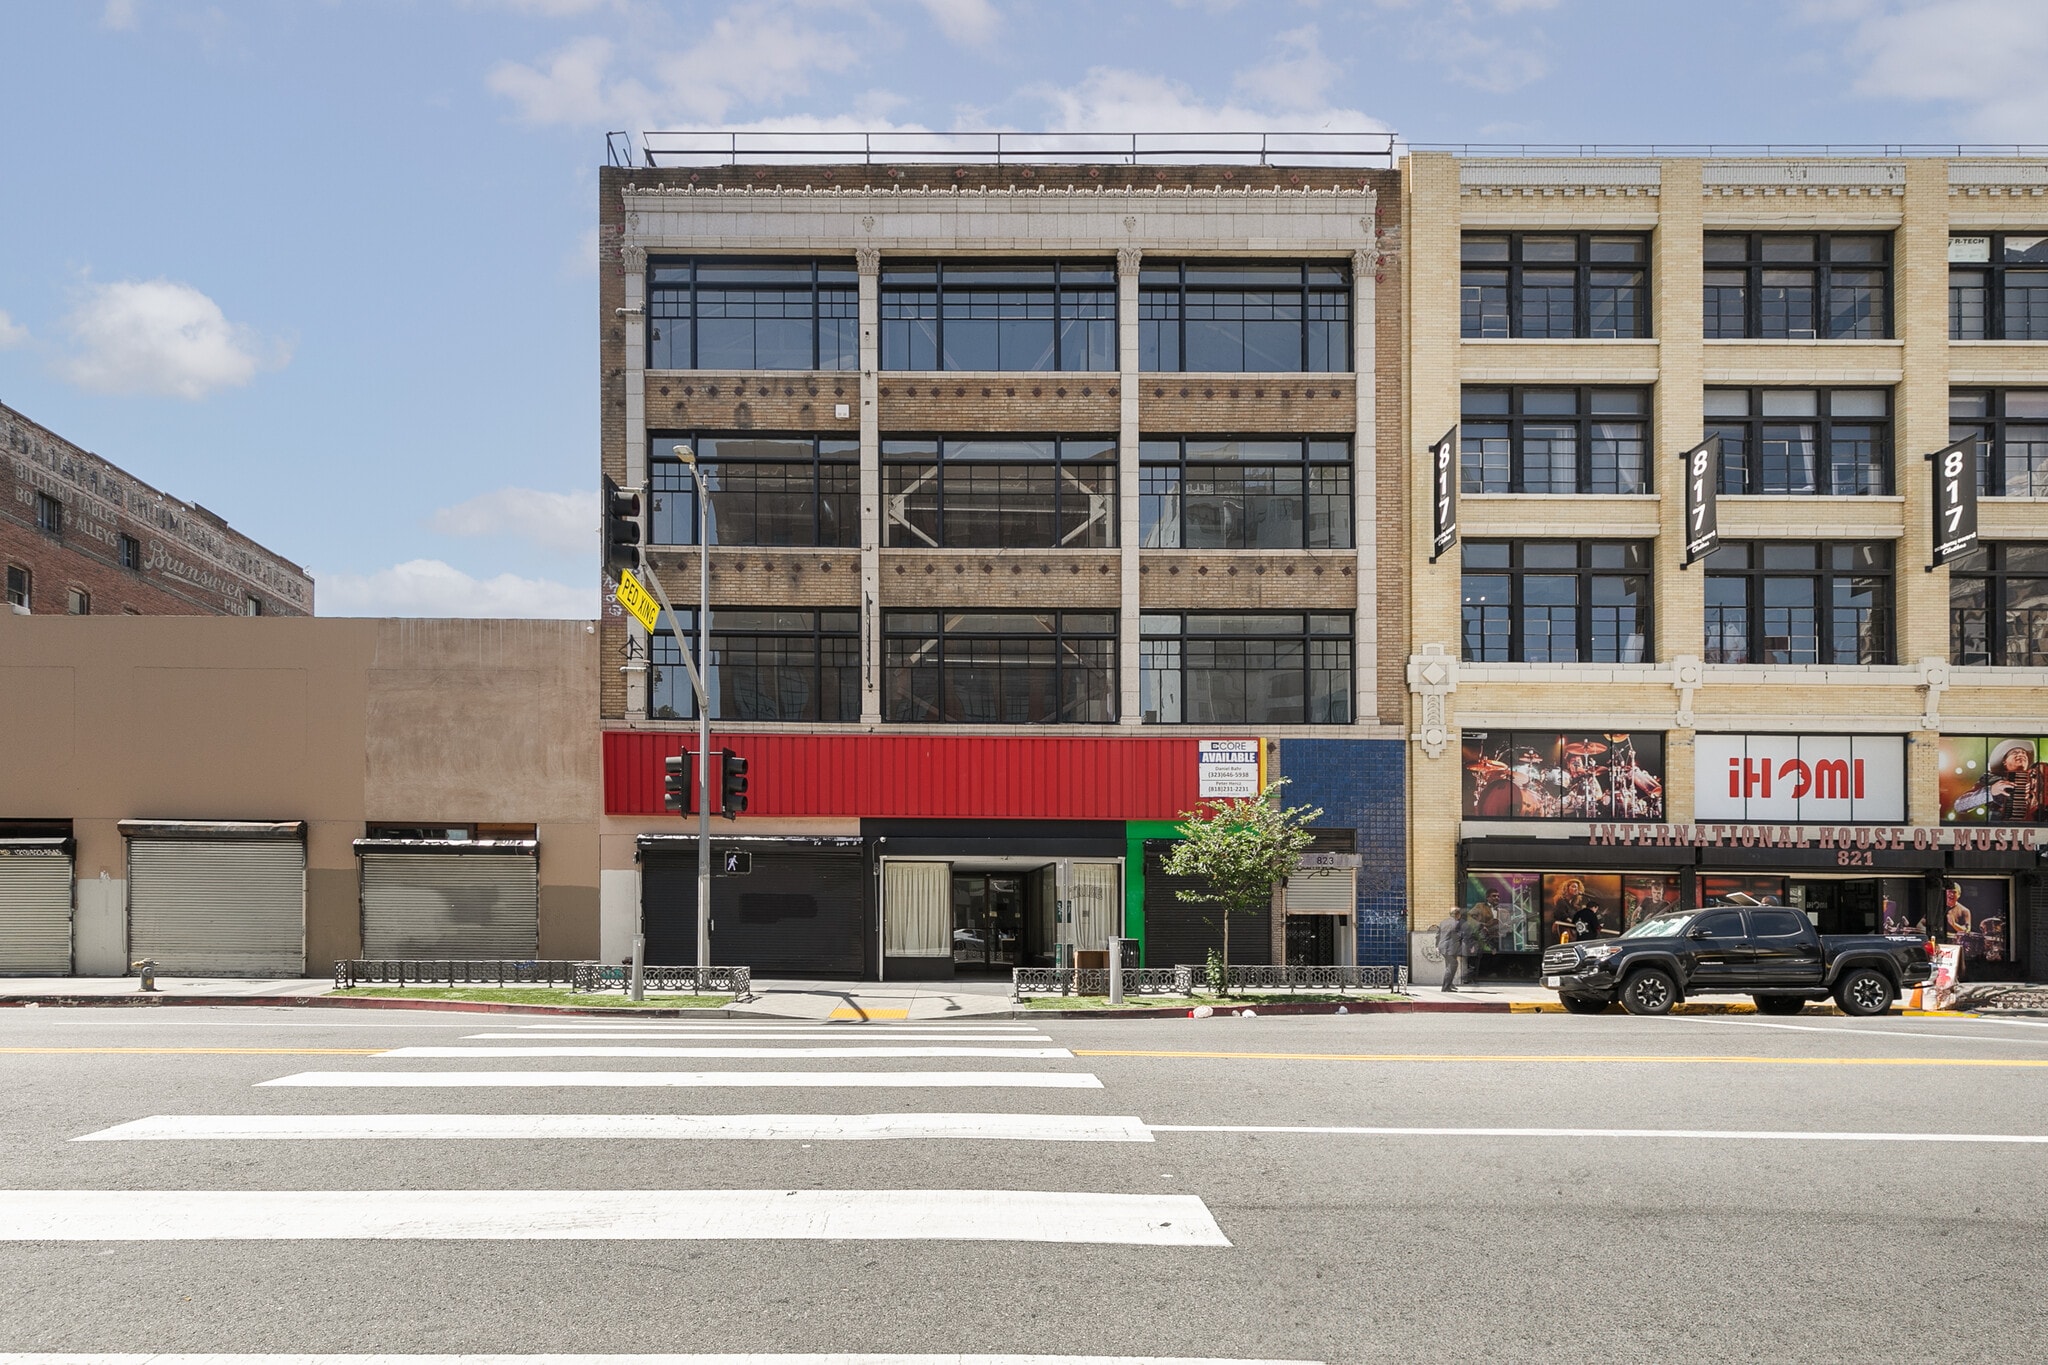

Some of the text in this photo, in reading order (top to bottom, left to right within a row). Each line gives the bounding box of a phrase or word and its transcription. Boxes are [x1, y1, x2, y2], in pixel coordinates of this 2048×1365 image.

[1439, 442, 1450, 524] 817
[1692, 450, 1708, 531] 817
[1944, 451, 1964, 533] 817
[76, 516, 118, 547] ALLEYS
[143, 540, 246, 605] Brunswick
[621, 578, 656, 625] PED XING
[1202, 752, 1256, 763] AVAILABLE
[1588, 824, 2036, 851] INTERNATIONAL HOUSE OF MUSIC
[1316, 856, 1334, 865] 823
[1837, 851, 1874, 866] 821
